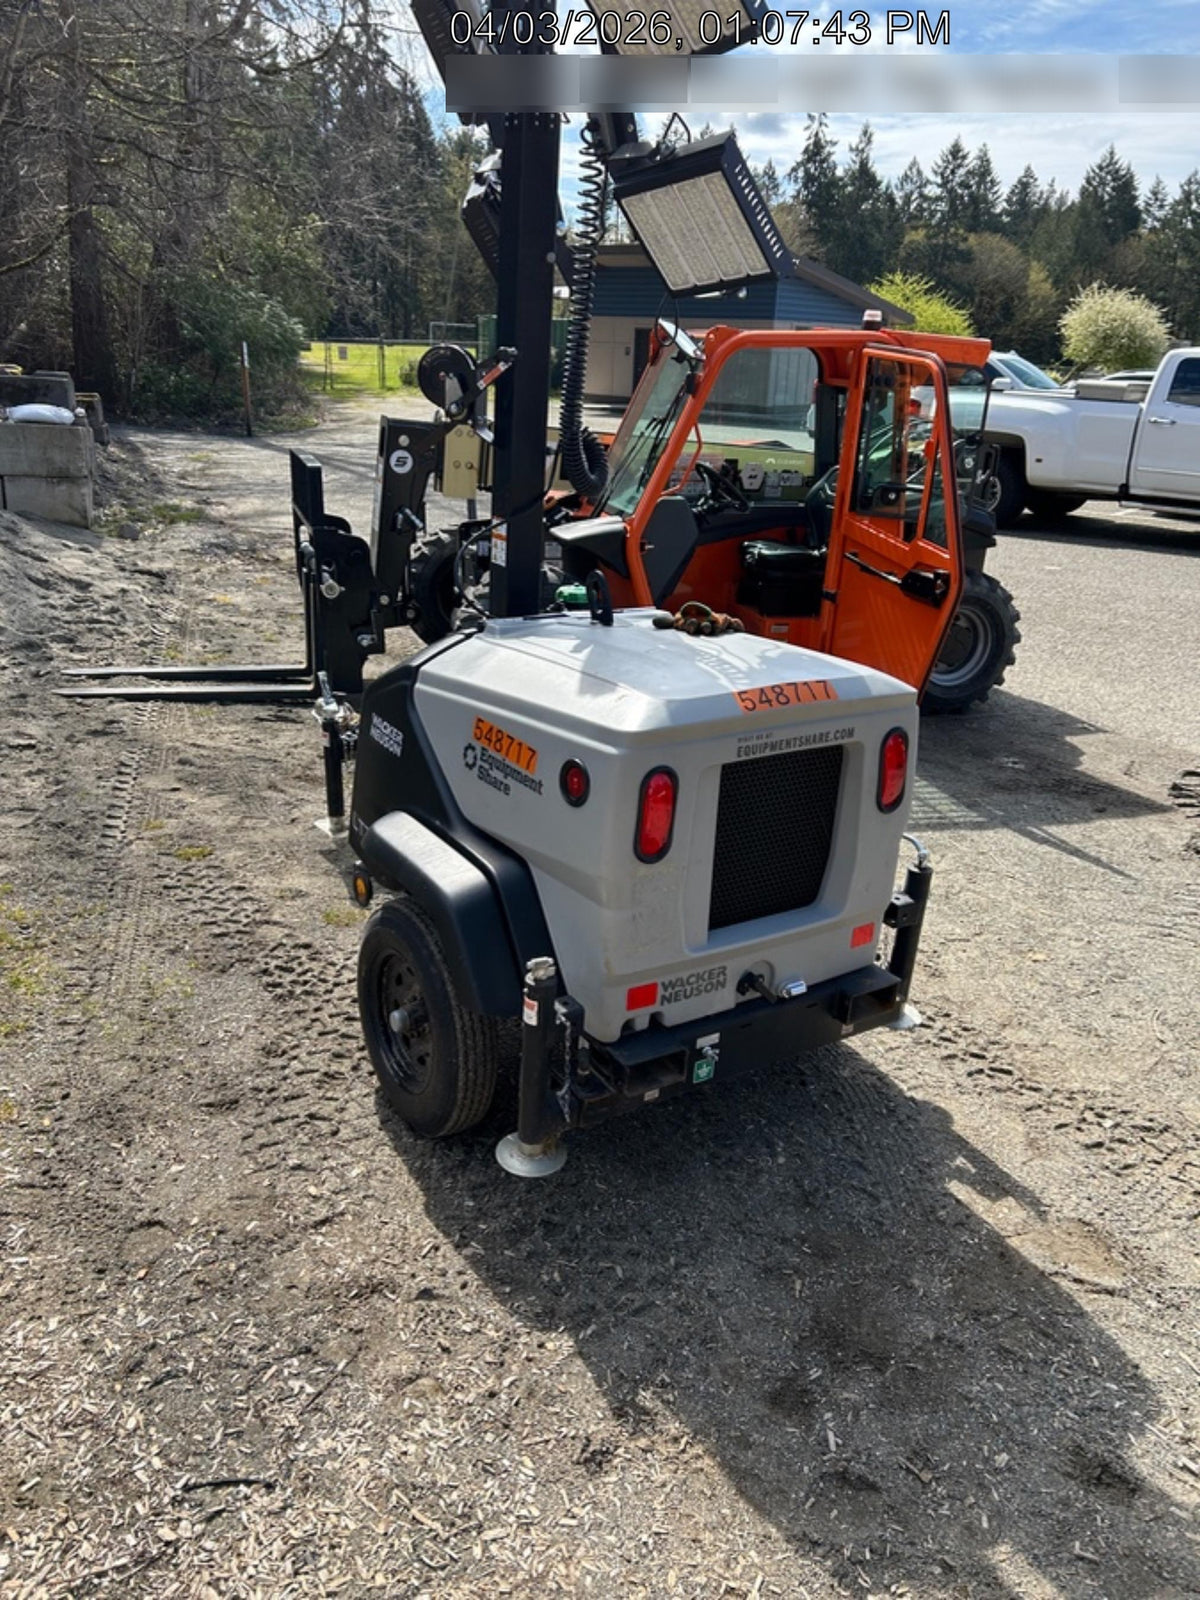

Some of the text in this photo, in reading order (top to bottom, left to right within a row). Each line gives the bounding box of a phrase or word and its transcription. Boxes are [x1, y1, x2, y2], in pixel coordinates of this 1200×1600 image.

[738, 680, 832, 712] 548717
[474, 718, 538, 771] 548717
[737, 727, 856, 758] EQUIPMENTSHARE.COM
[477, 766, 511, 796] Share
[479, 745, 544, 796] Equipment
[660, 965, 727, 993] WACKER
[660, 977, 727, 1006] NEUSON
